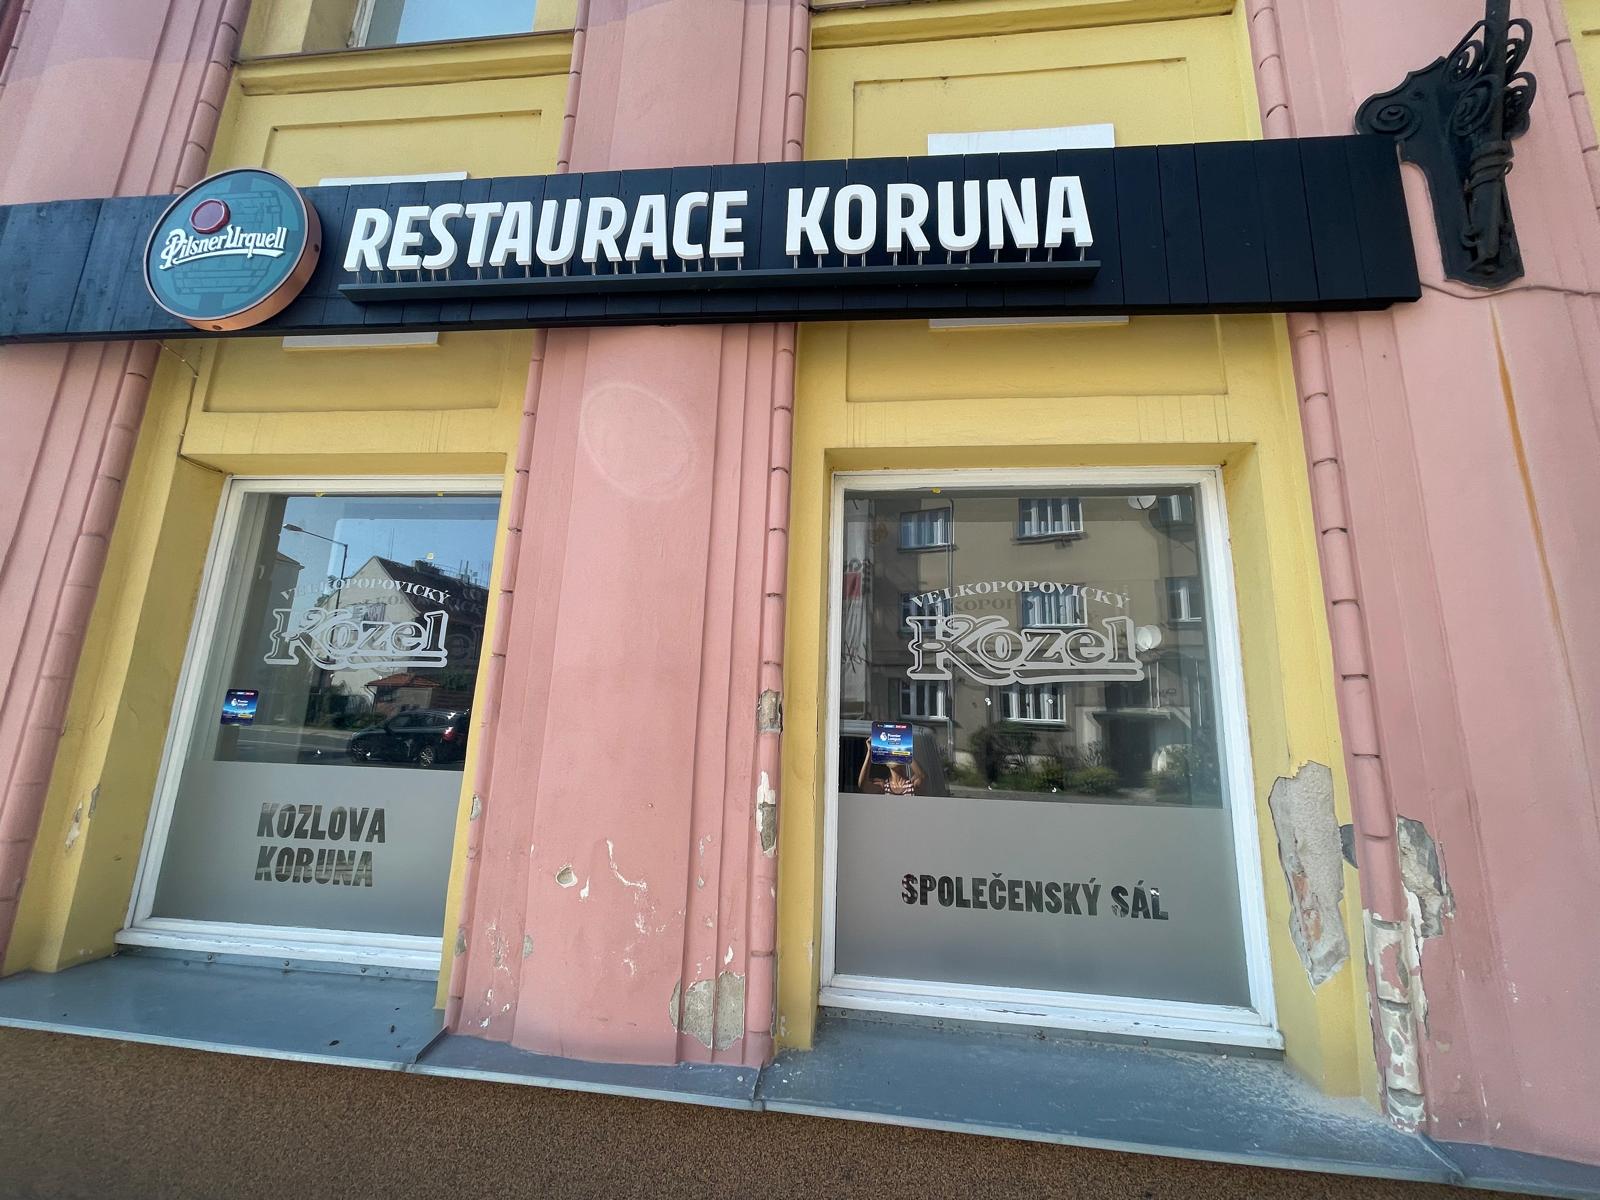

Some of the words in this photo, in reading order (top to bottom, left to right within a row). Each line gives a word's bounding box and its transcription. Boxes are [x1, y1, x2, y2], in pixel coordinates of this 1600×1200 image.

[159, 228, 228, 270] Pilsner
[224, 224, 288, 258] Urquell
[343, 190, 747, 272] RESTAURACE
[785, 176, 1093, 256] KORUNA
[281, 578, 451, 604] VKOPOPOVICKÝ
[264, 607, 449, 670] Kozel
[906, 614, 1145, 686] Kozel
[257, 802, 386, 843] KOZLOVA
[254, 845, 373, 887] KORUNA
[901, 873, 1101, 916] SPOLEČENSKÝ
[1110, 879, 1169, 921] SÁL
